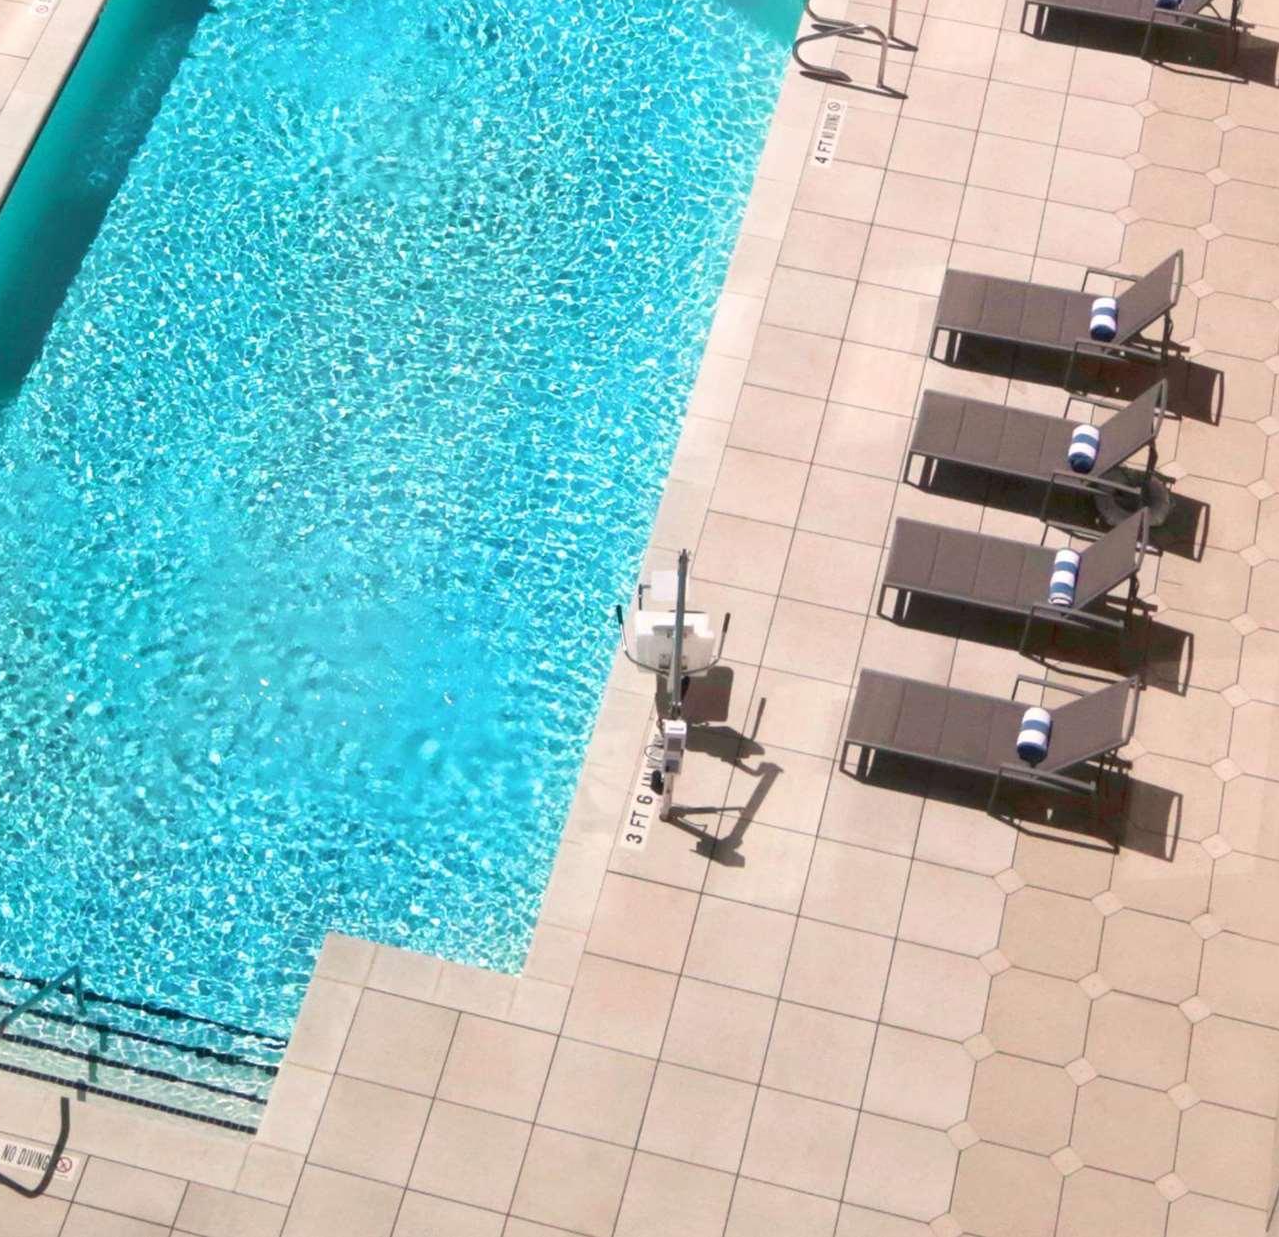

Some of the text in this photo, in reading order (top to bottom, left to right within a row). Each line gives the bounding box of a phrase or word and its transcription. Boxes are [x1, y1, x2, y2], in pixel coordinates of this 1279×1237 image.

[817, 140, 833, 153] FT
[815, 156, 829, 164] 4
[637, 794, 653, 805] 6
[630, 810, 649, 829] FT
[626, 833, 643, 844] 3
[1, 1144, 16, 1163] NO
[17, 1147, 51, 1172] DIVING
